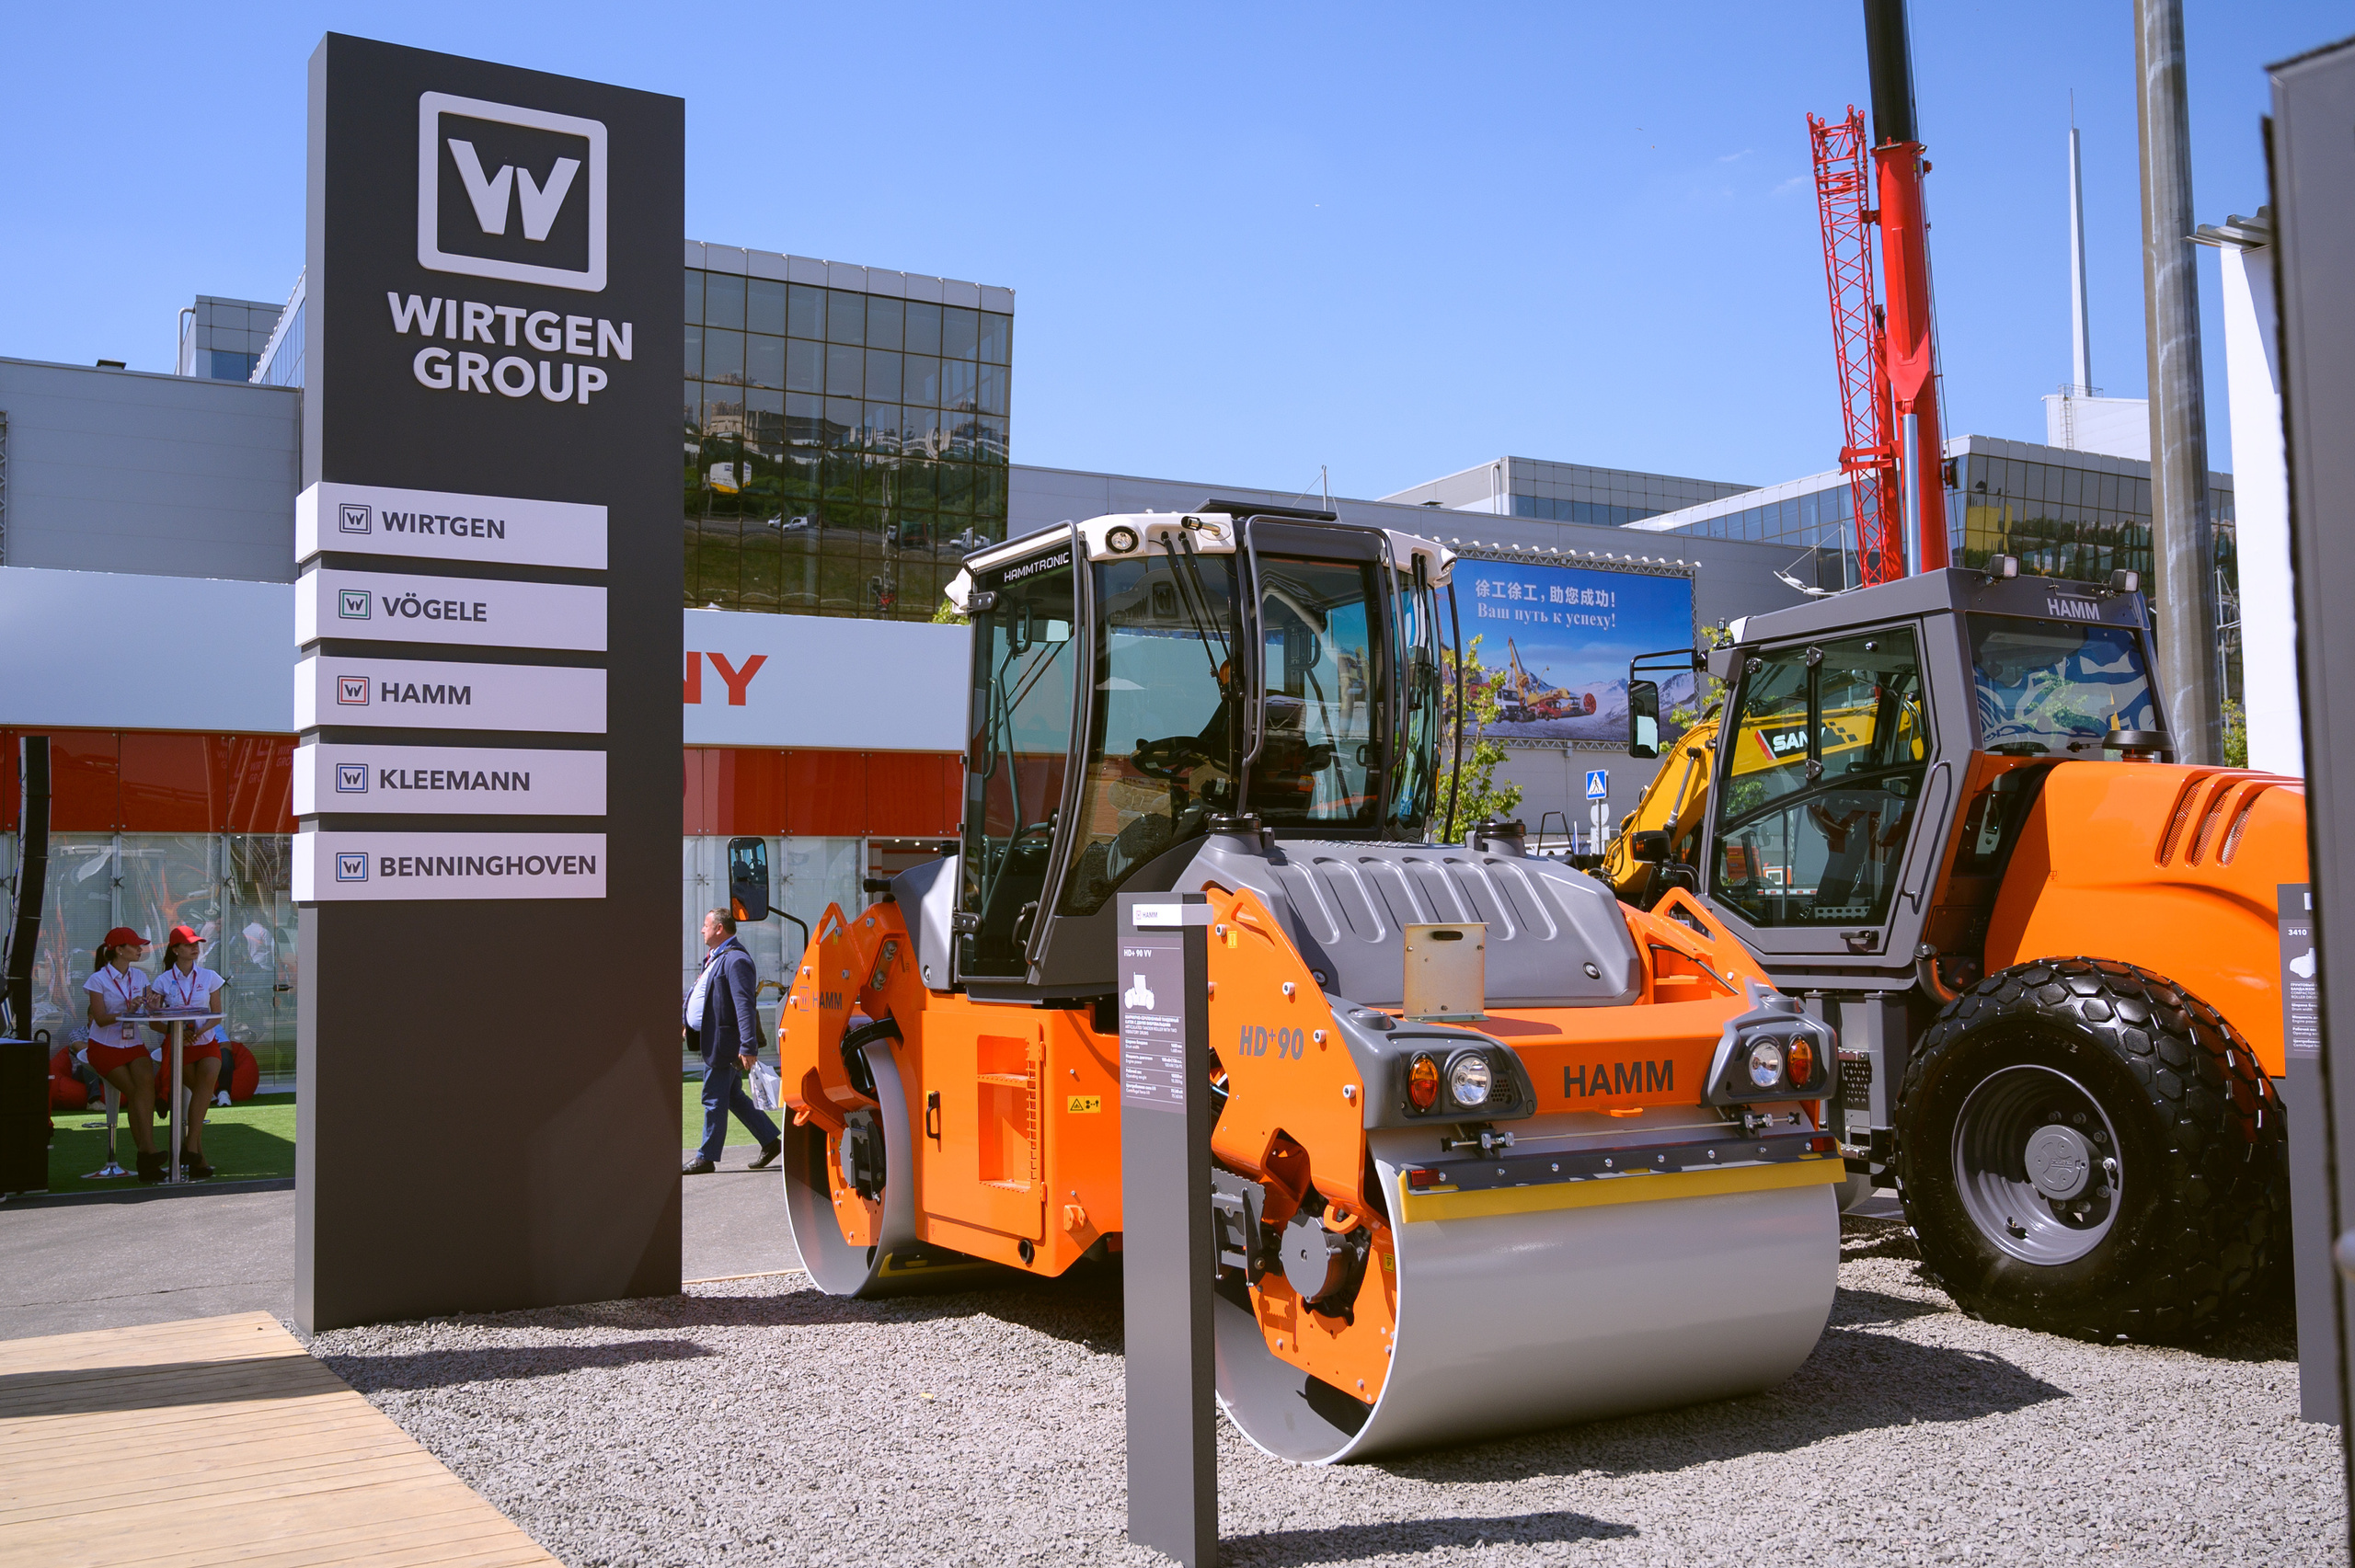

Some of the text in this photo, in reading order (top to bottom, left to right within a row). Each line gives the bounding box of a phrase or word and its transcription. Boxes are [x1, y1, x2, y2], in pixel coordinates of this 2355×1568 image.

[386, 291, 633, 361] WIRTGEN
[413, 346, 608, 405] GROUP
[382, 510, 505, 540] WIRTGEN
[1004, 551, 1070, 583] HAMMTRONIC
[382, 591, 488, 623] VÖGELE
[1477, 602, 1616, 631] Ваш путь к успеху!
[2047, 598, 2100, 621] HAMM
[381, 682, 472, 705] HAMM
[1773, 727, 1825, 752] SAN
[379, 769, 531, 792] KLEEMANN
[380, 855, 597, 877] BENNINGHOVEN
[1123, 949, 1135, 957] HD+
[1136, 949, 1143, 957] 90
[813, 990, 843, 1011] HAMM
[1563, 1059, 1674, 1098] HAMM
